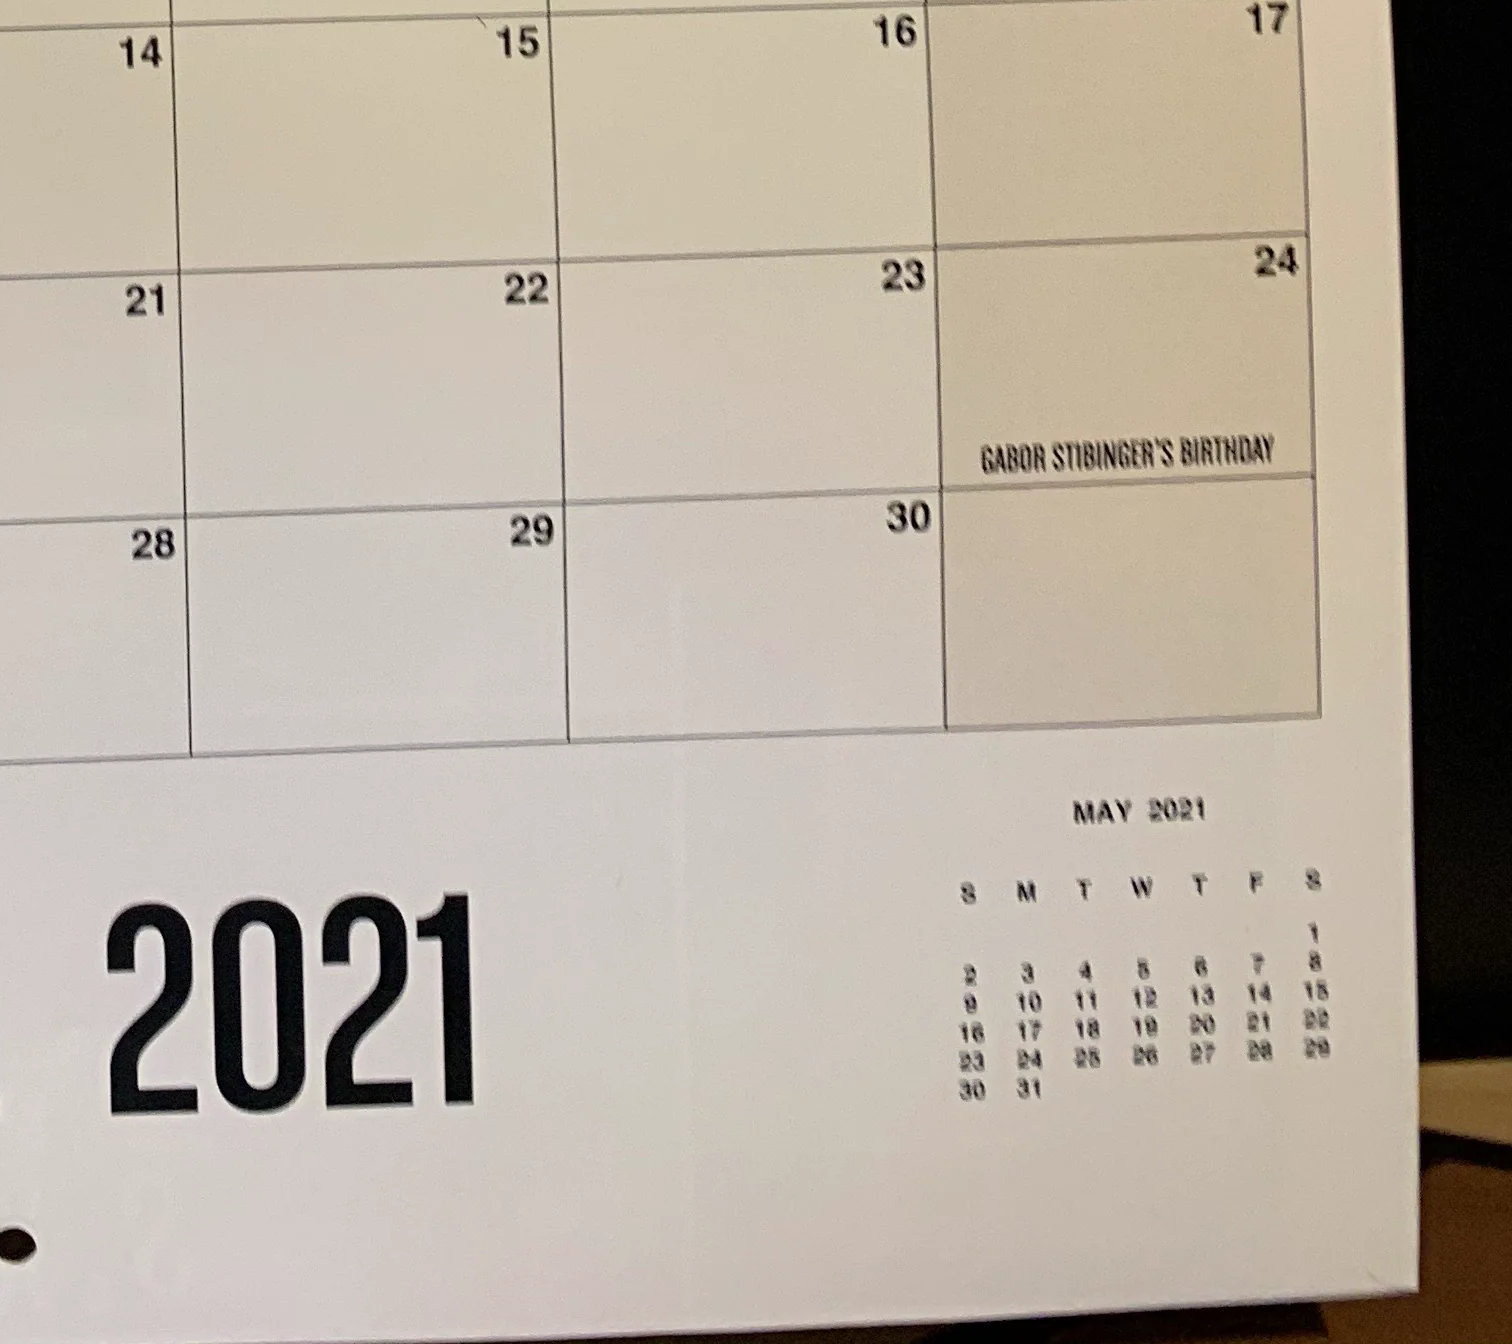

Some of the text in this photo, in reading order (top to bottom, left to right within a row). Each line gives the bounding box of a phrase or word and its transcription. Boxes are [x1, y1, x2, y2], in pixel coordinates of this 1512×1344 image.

[120, 37, 161, 67] 14
[498, 27, 539, 57] 15
[875, 16, 916, 46] 16
[1248, 3, 1288, 33] 17
[127, 285, 163, 315] 21
[506, 272, 548, 304] 22
[883, 260, 925, 290] 23
[1256, 246, 1299, 276] 24
[981, 433, 1275, 474] GABOR STIBINGER'S BIRTHDAY
[133, 529, 174, 559] 28
[511, 515, 553, 545] 29
[888, 501, 930, 531] 30
[1074, 797, 1204, 823] MAY 2021
[961, 870, 1321, 904] S M T W T F S
[105, 893, 475, 1116] 2021
